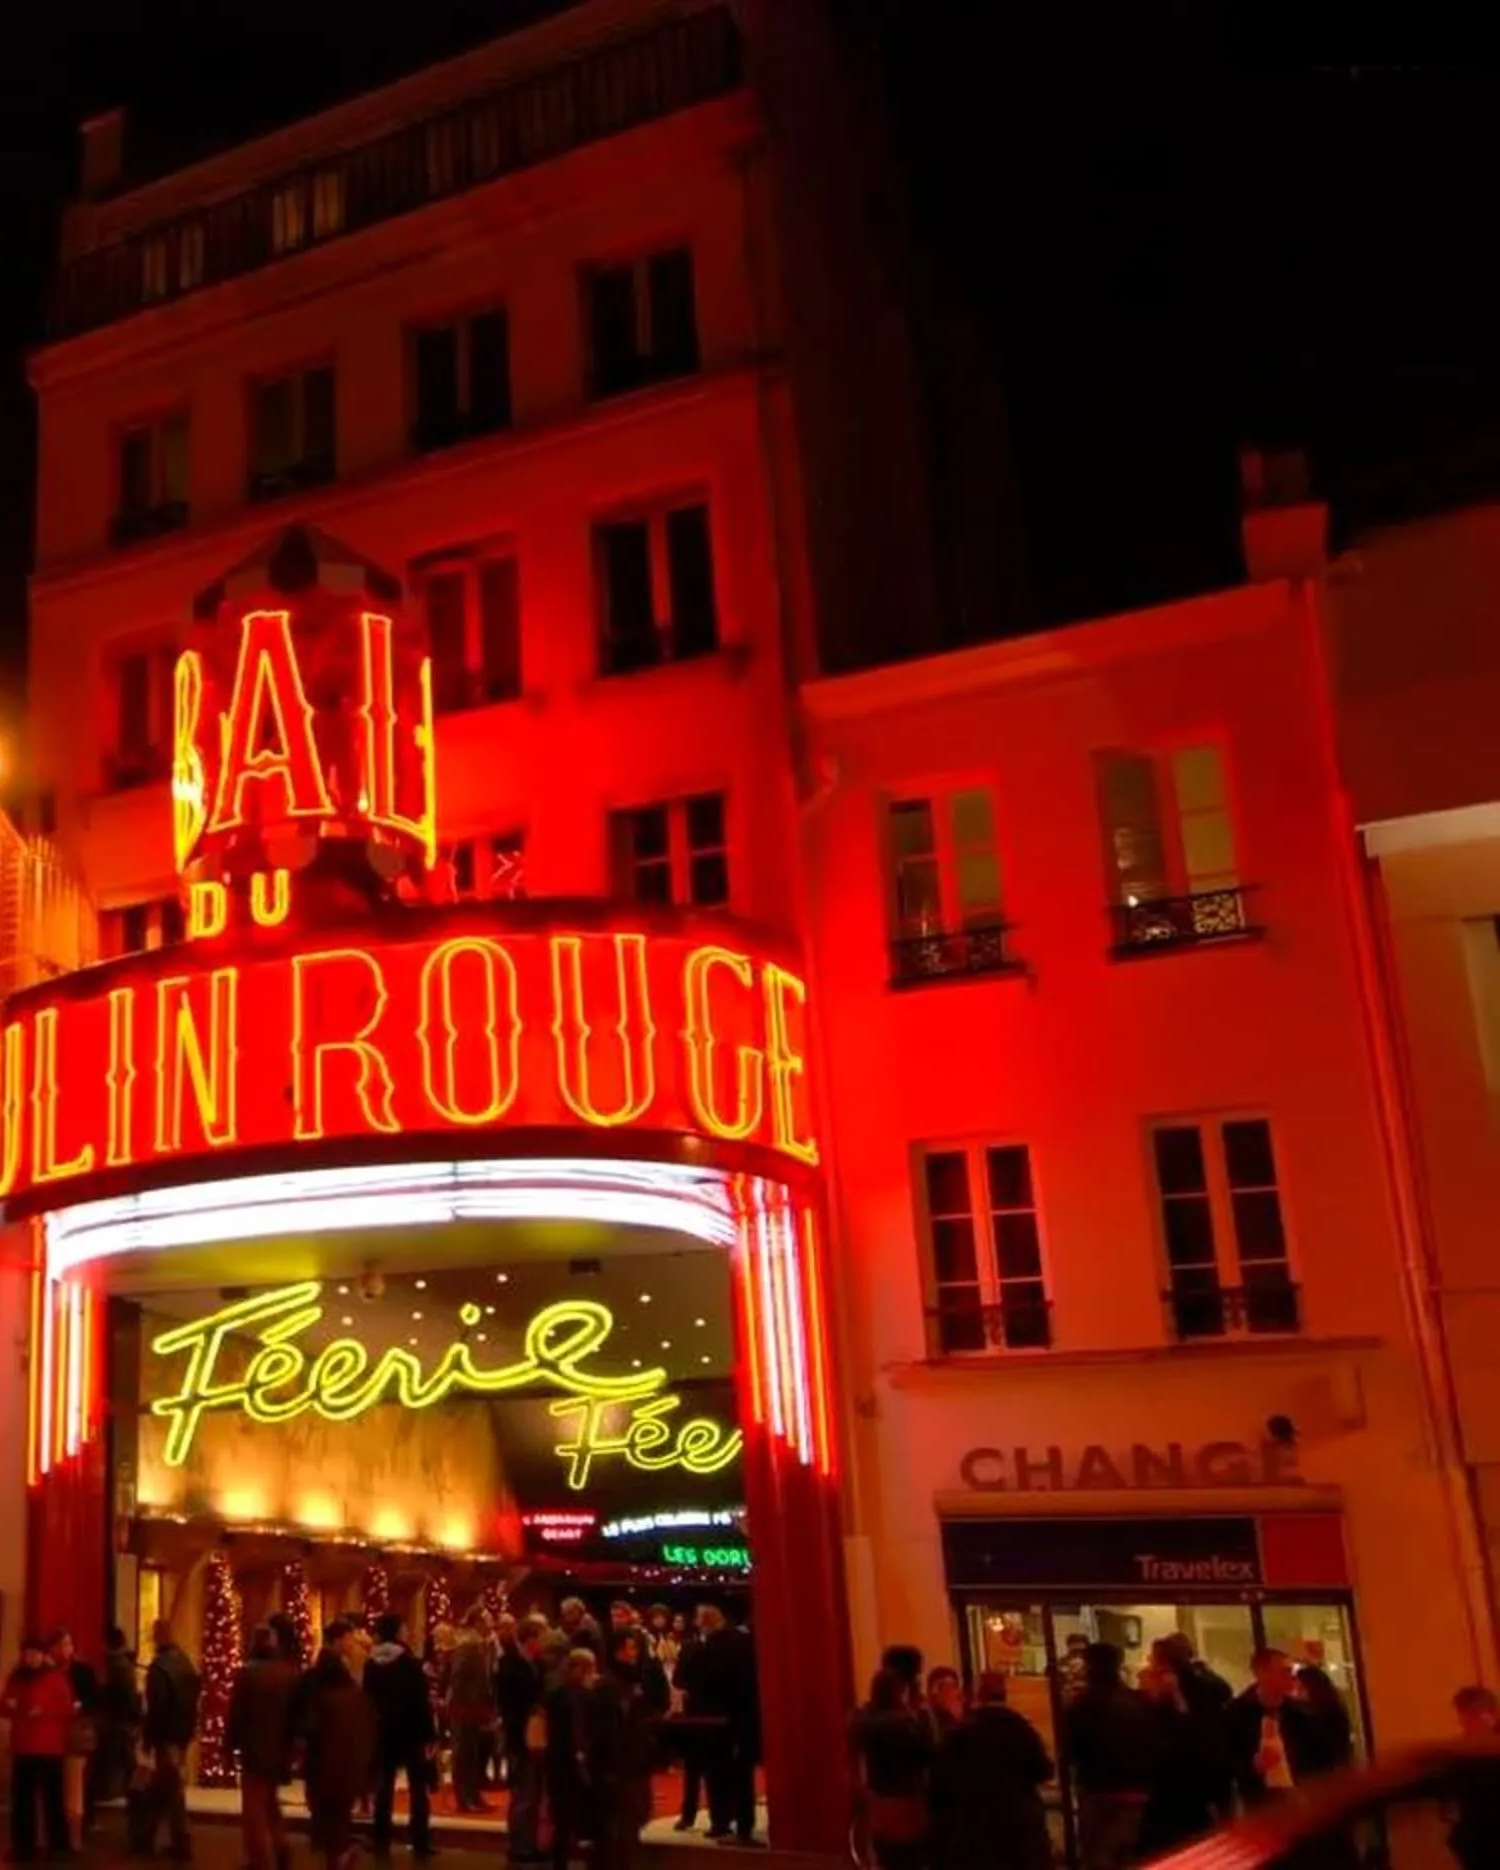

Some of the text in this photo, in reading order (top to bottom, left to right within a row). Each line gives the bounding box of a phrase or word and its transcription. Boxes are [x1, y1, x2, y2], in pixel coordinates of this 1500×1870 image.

[172, 609, 437, 874] BAL
[188, 868, 291, 939] DU
[290, 935, 820, 1166] ROUGE
[152, 1281, 666, 1466] Féerie
[959, 1440, 1306, 1492] CHANGE
[1134, 1553, 1256, 1582] Travelex
